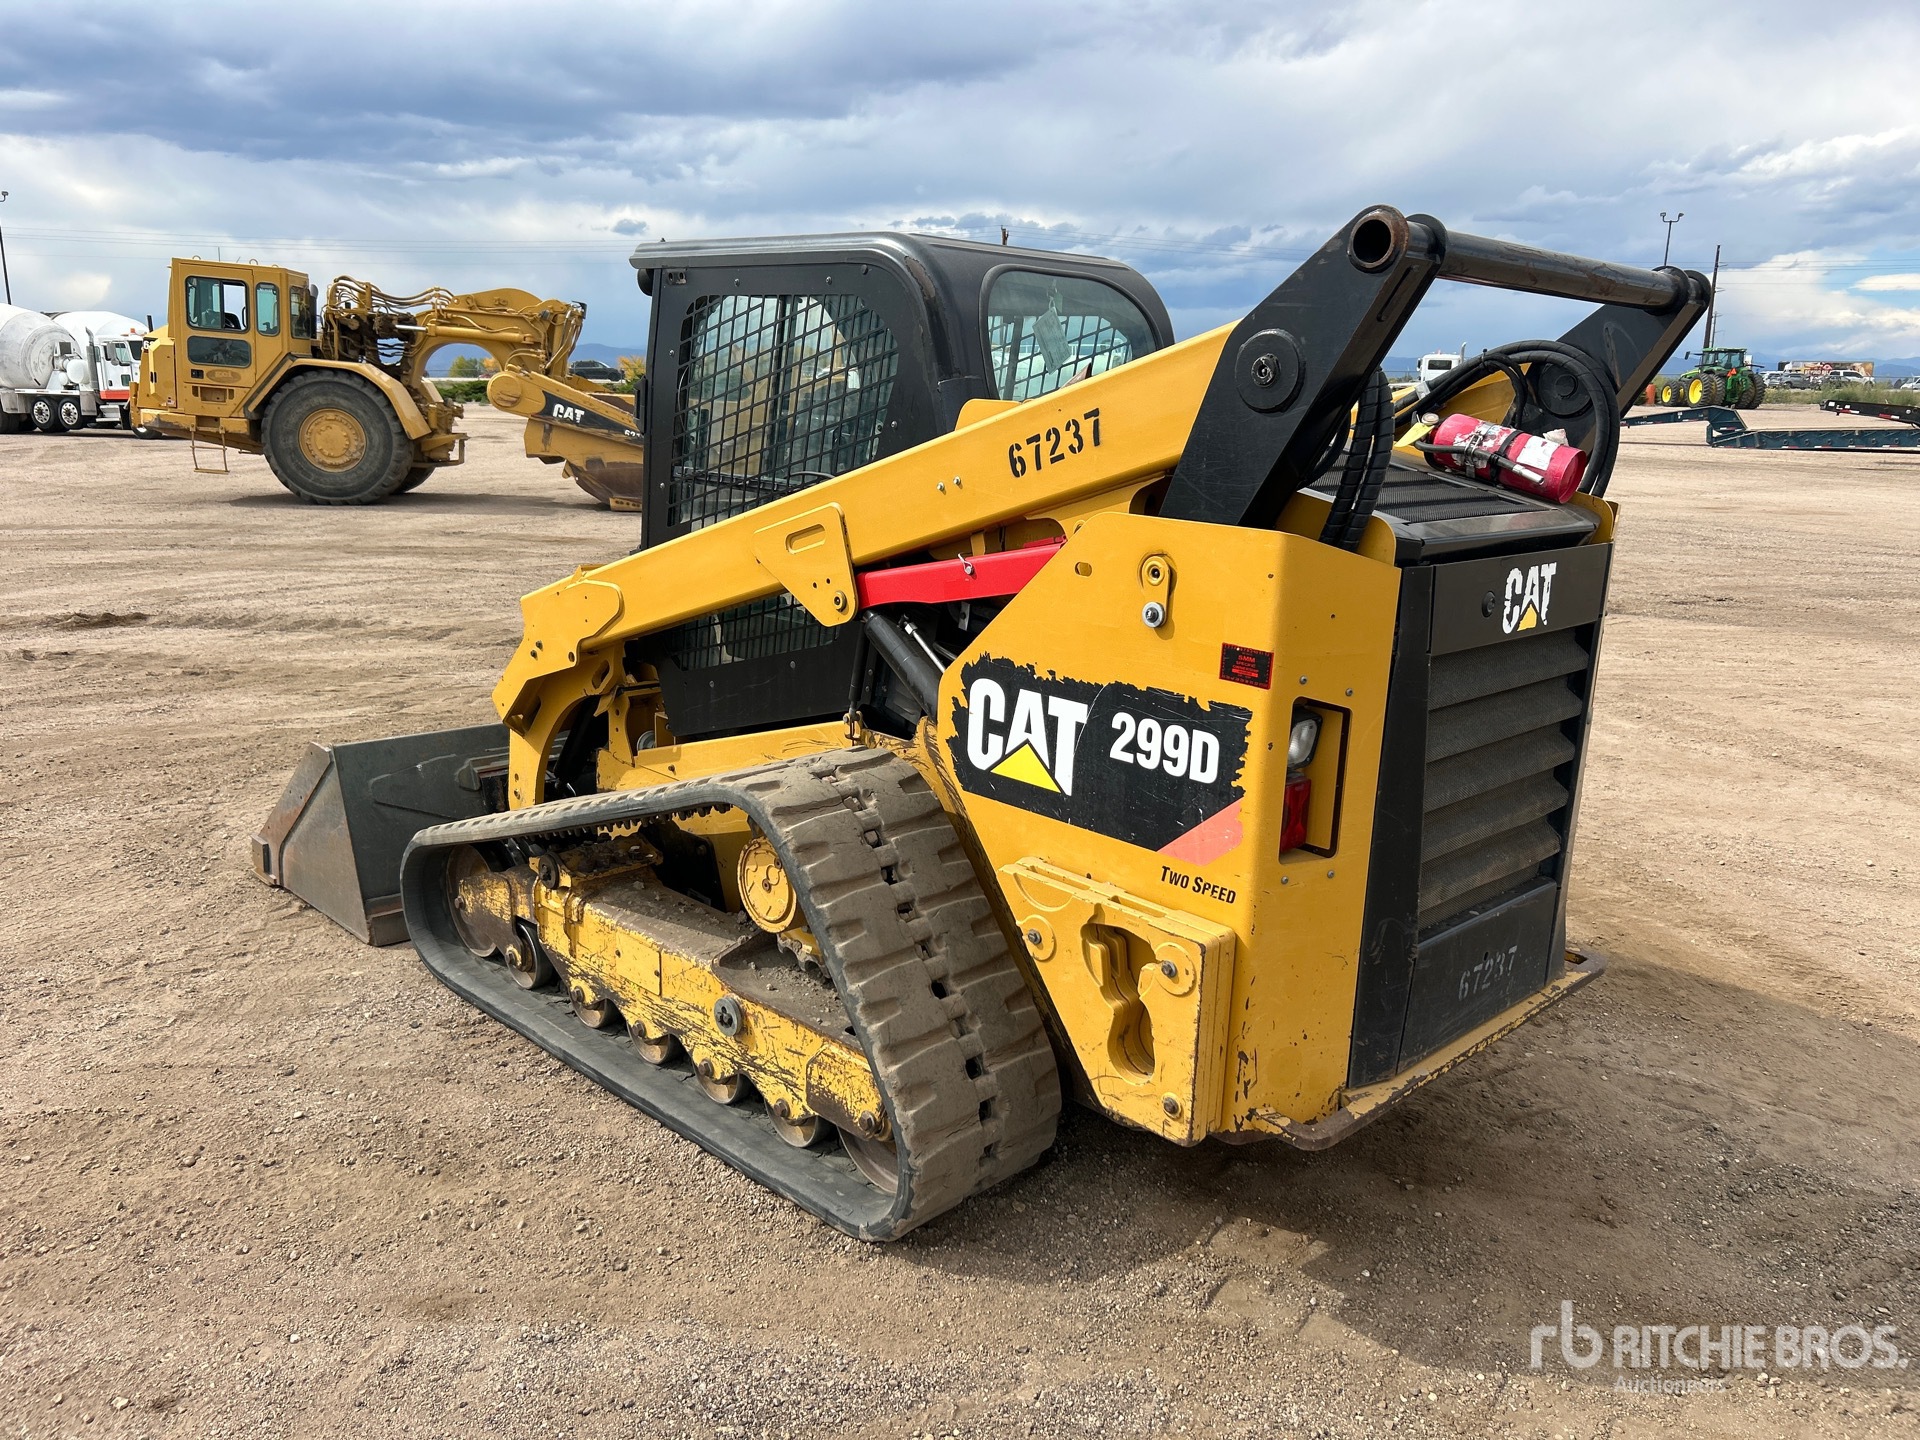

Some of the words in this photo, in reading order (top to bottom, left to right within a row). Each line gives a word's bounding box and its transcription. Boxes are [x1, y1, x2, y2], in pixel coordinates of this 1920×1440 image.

[552, 403, 585, 423] CAT
[1009, 408, 1100, 478] 67237
[1503, 562, 1557, 634] CAT
[967, 678, 1088, 796] CAT
[1110, 712, 1219, 784] 299D
[1459, 945, 1517, 1001] 67237
